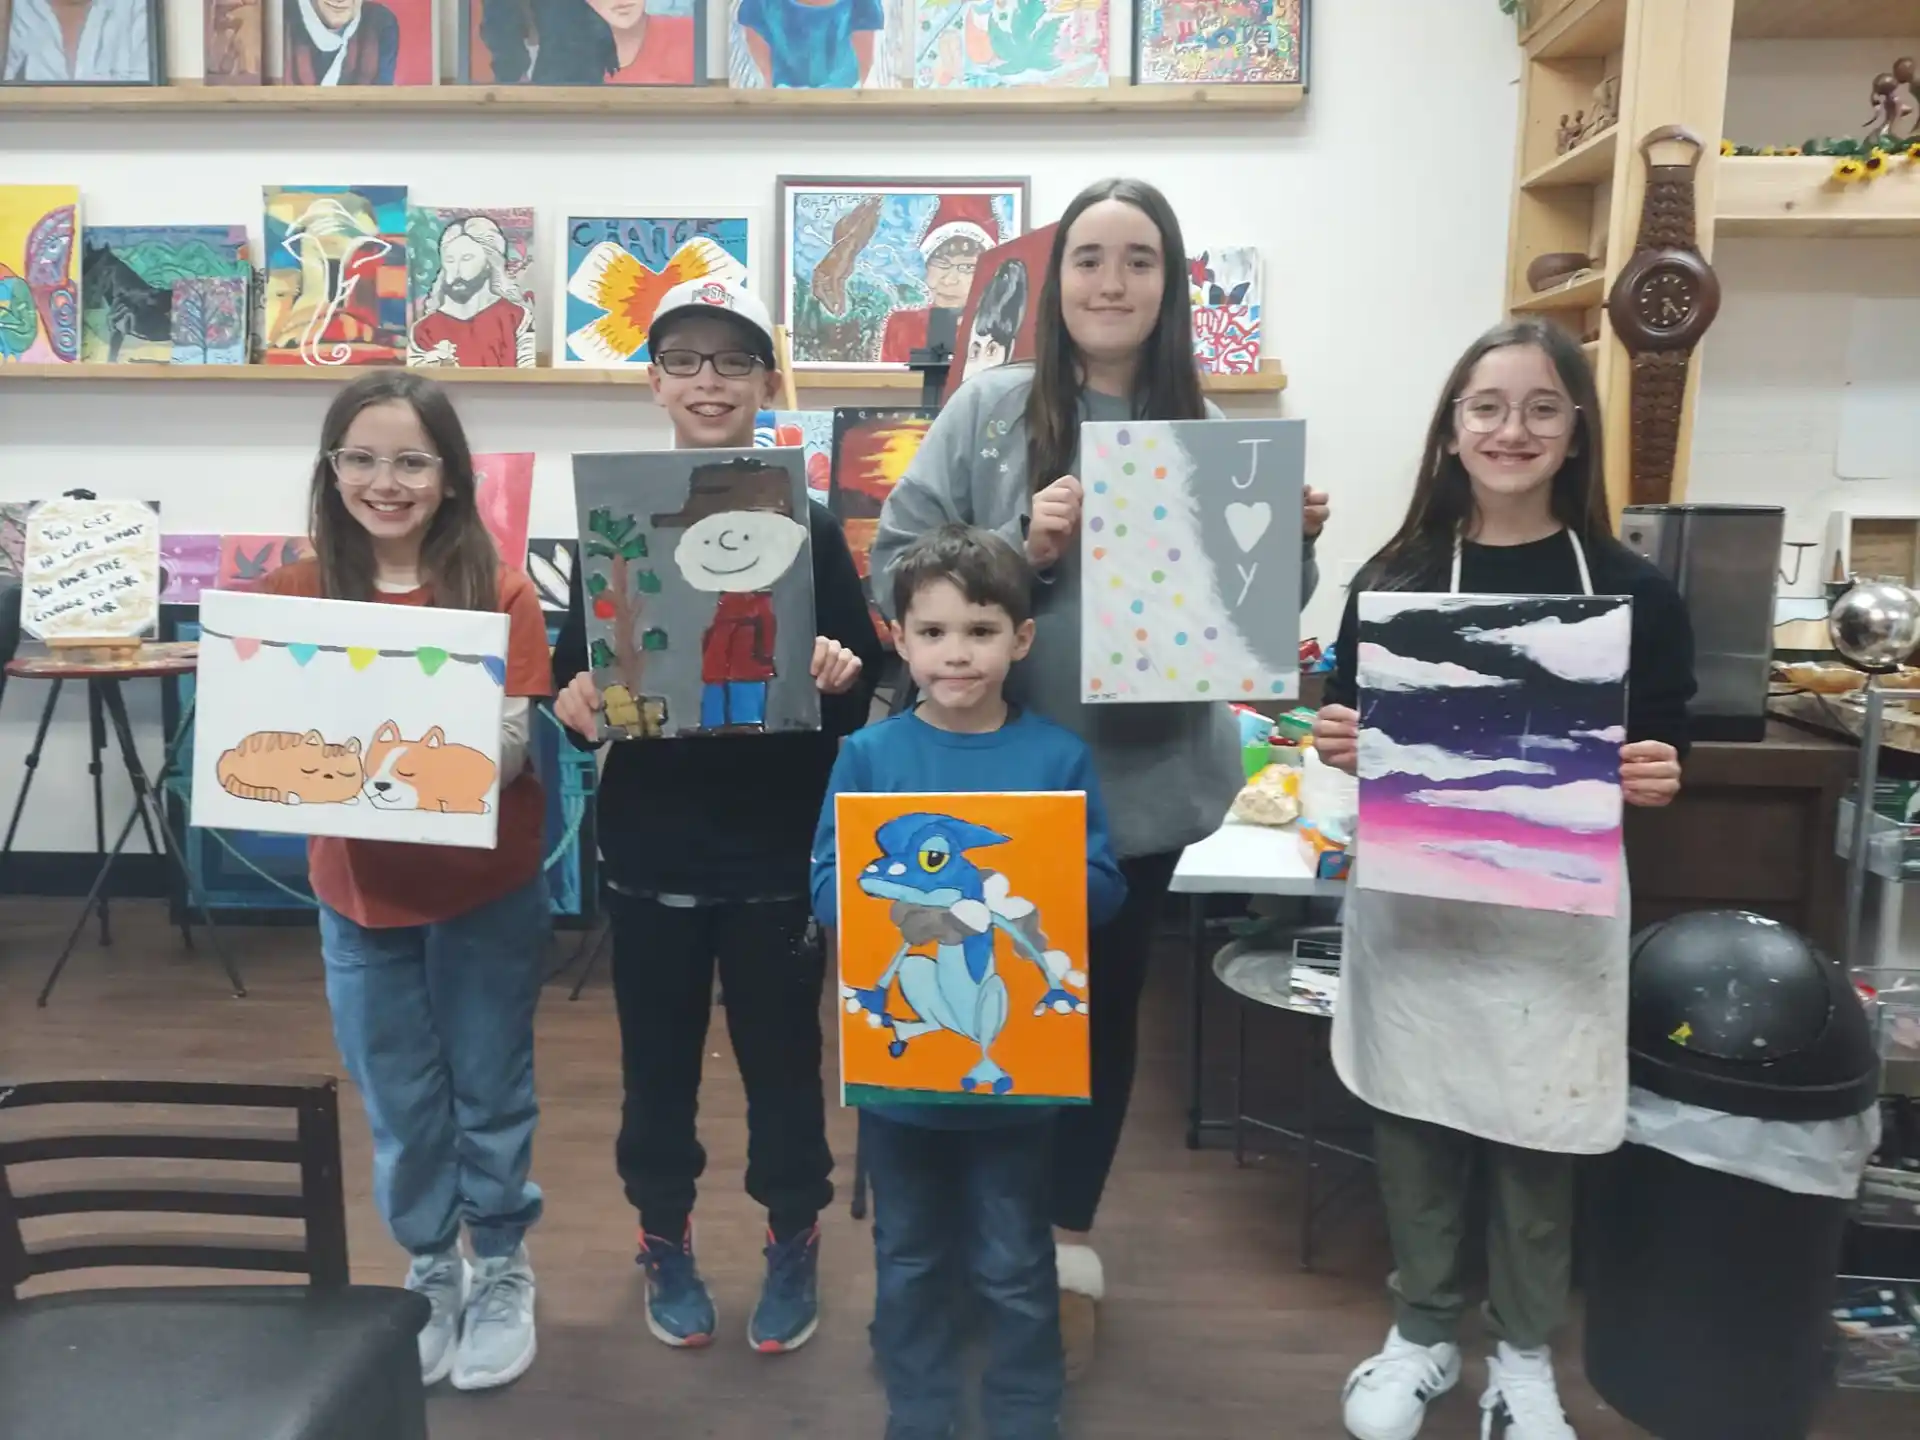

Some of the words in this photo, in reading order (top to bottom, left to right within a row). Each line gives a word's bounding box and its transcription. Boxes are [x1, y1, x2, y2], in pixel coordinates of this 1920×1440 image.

[42, 525, 72, 541] YOU
[40, 555, 54, 569] IN
[61, 540, 94, 559] LIFE
[58, 569, 88, 589] HAVE
[94, 557, 122, 574] THE
[109, 575, 139, 591] ASK
